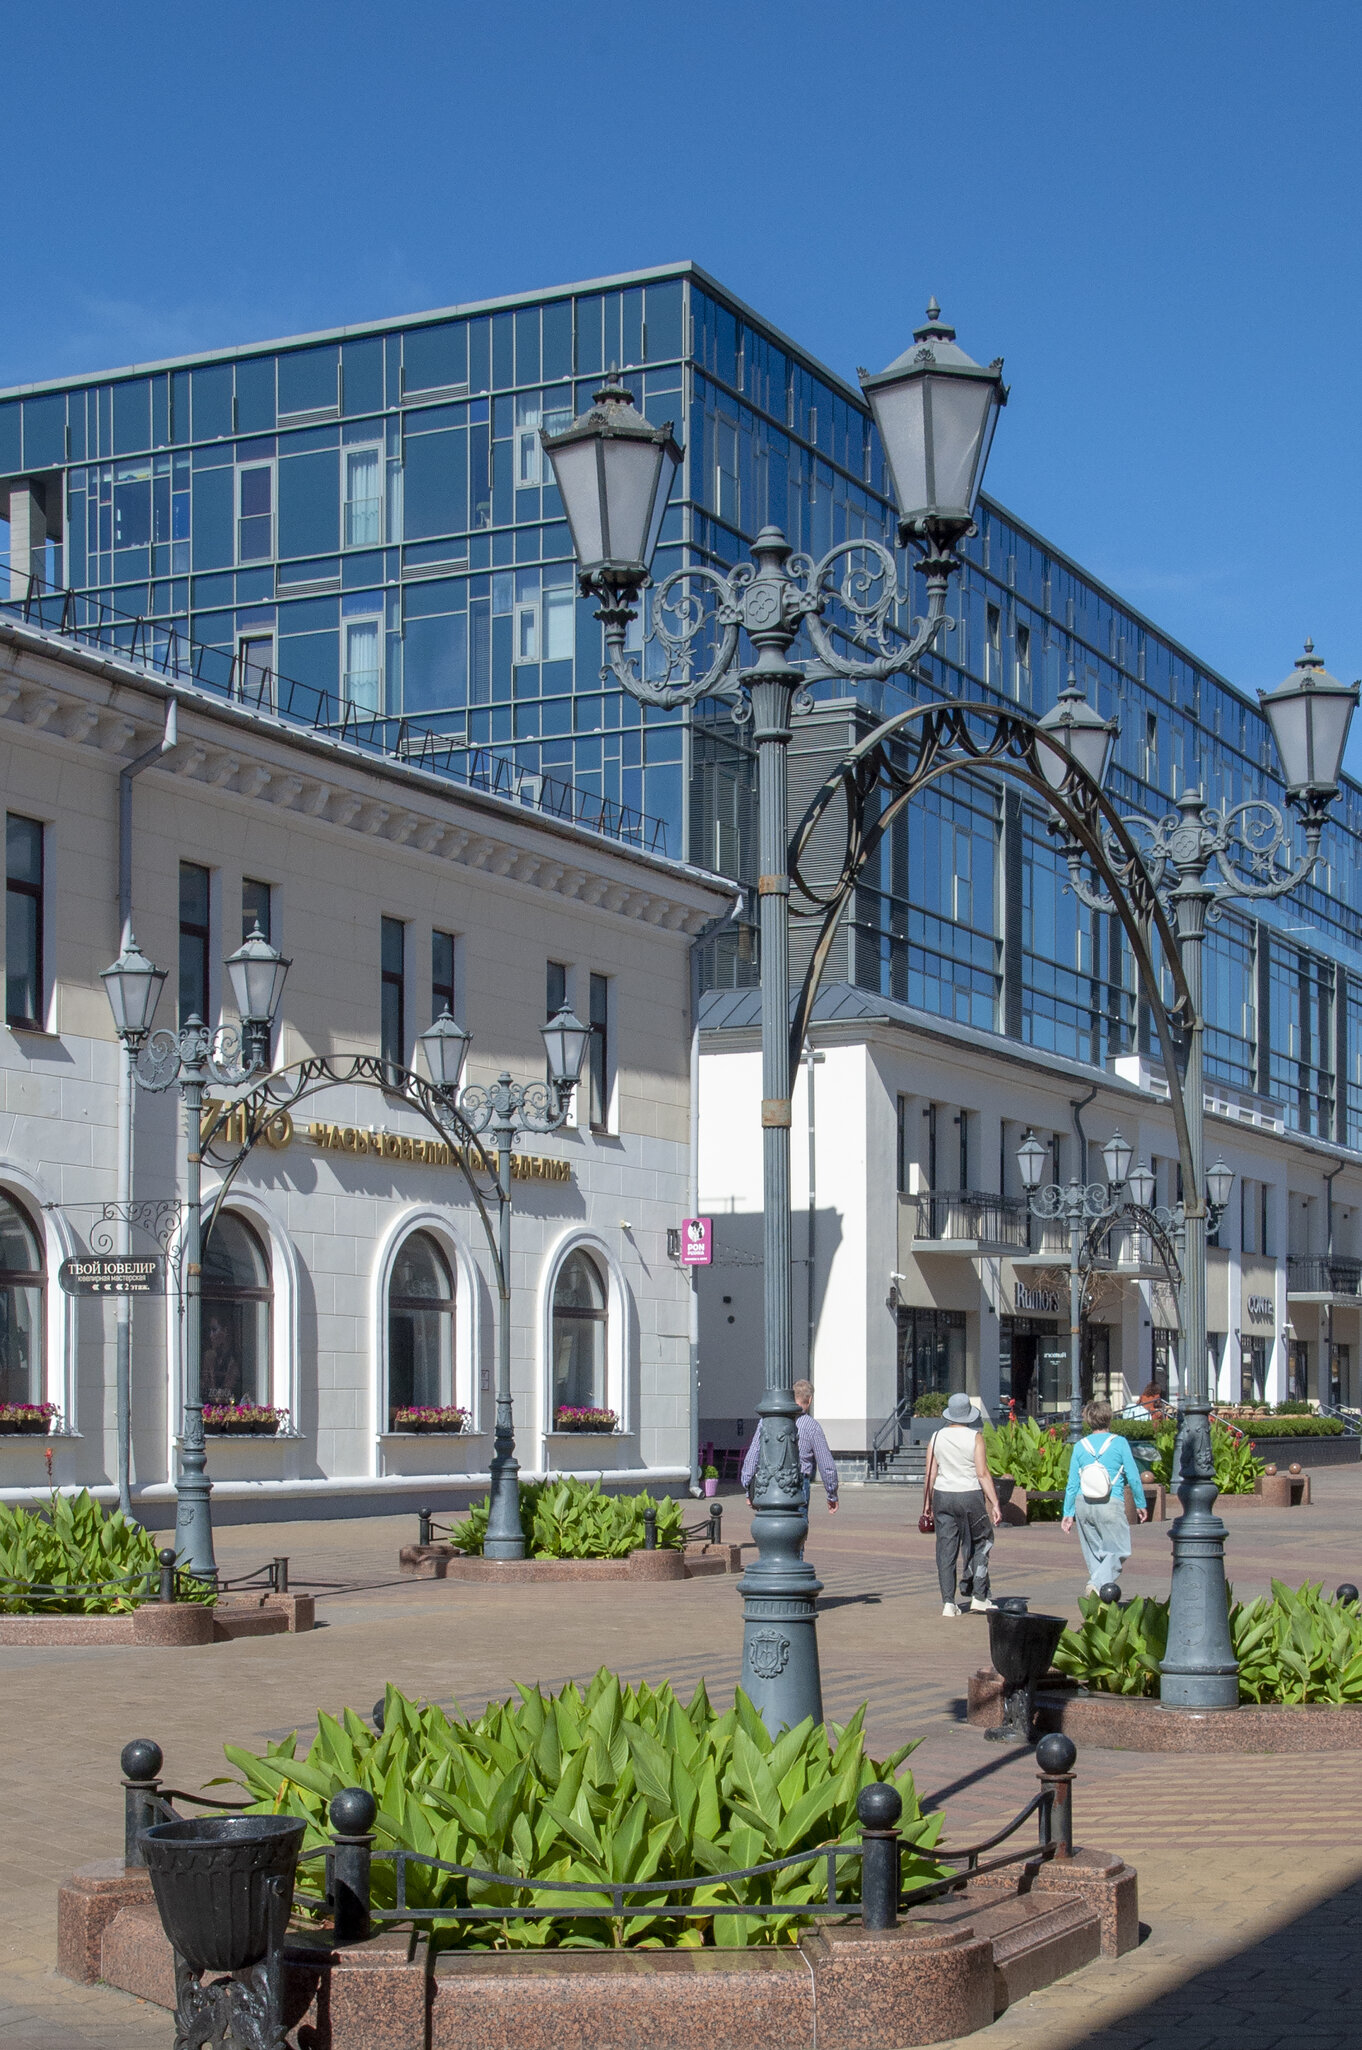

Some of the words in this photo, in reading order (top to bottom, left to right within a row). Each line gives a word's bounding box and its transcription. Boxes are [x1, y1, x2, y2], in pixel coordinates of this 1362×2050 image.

[310, 1122, 373, 1154] ЧАСЫ
[497, 1150, 571, 1182] ЗДЕЛИЯ
[687, 1243, 705, 1251] PON
[68, 1261, 101, 1274] ТВОЙ
[103, 1262, 156, 1274] ЮВЕЛИР
[78, 1274, 110, 1283] ювелирная
[111, 1274, 146, 1283] мастерская
[1015, 1281, 1060, 1312] Rumors
